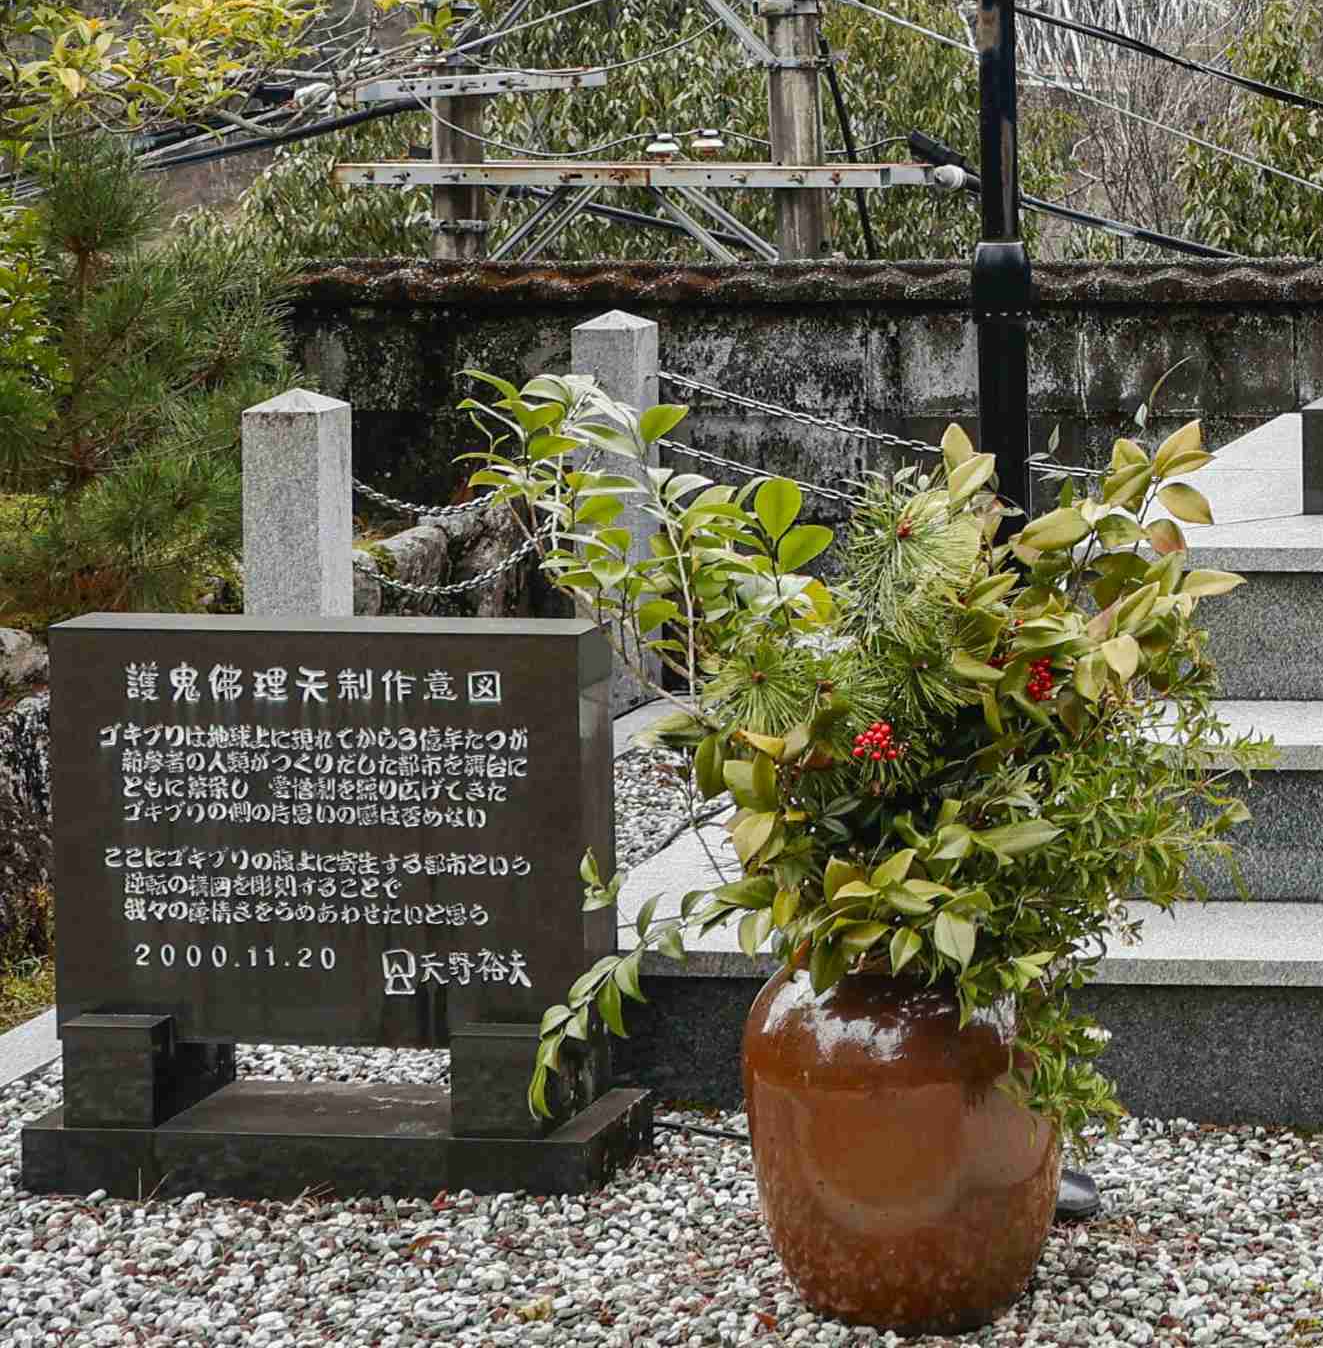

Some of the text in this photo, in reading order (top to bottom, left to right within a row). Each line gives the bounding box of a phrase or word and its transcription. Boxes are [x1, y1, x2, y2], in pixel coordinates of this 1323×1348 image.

[123, 872, 403, 899] 逆転の構図を彫刻することで
[134, 943, 336, 970] 2000.11.20
[420, 947, 532, 989] 天野裕夫
